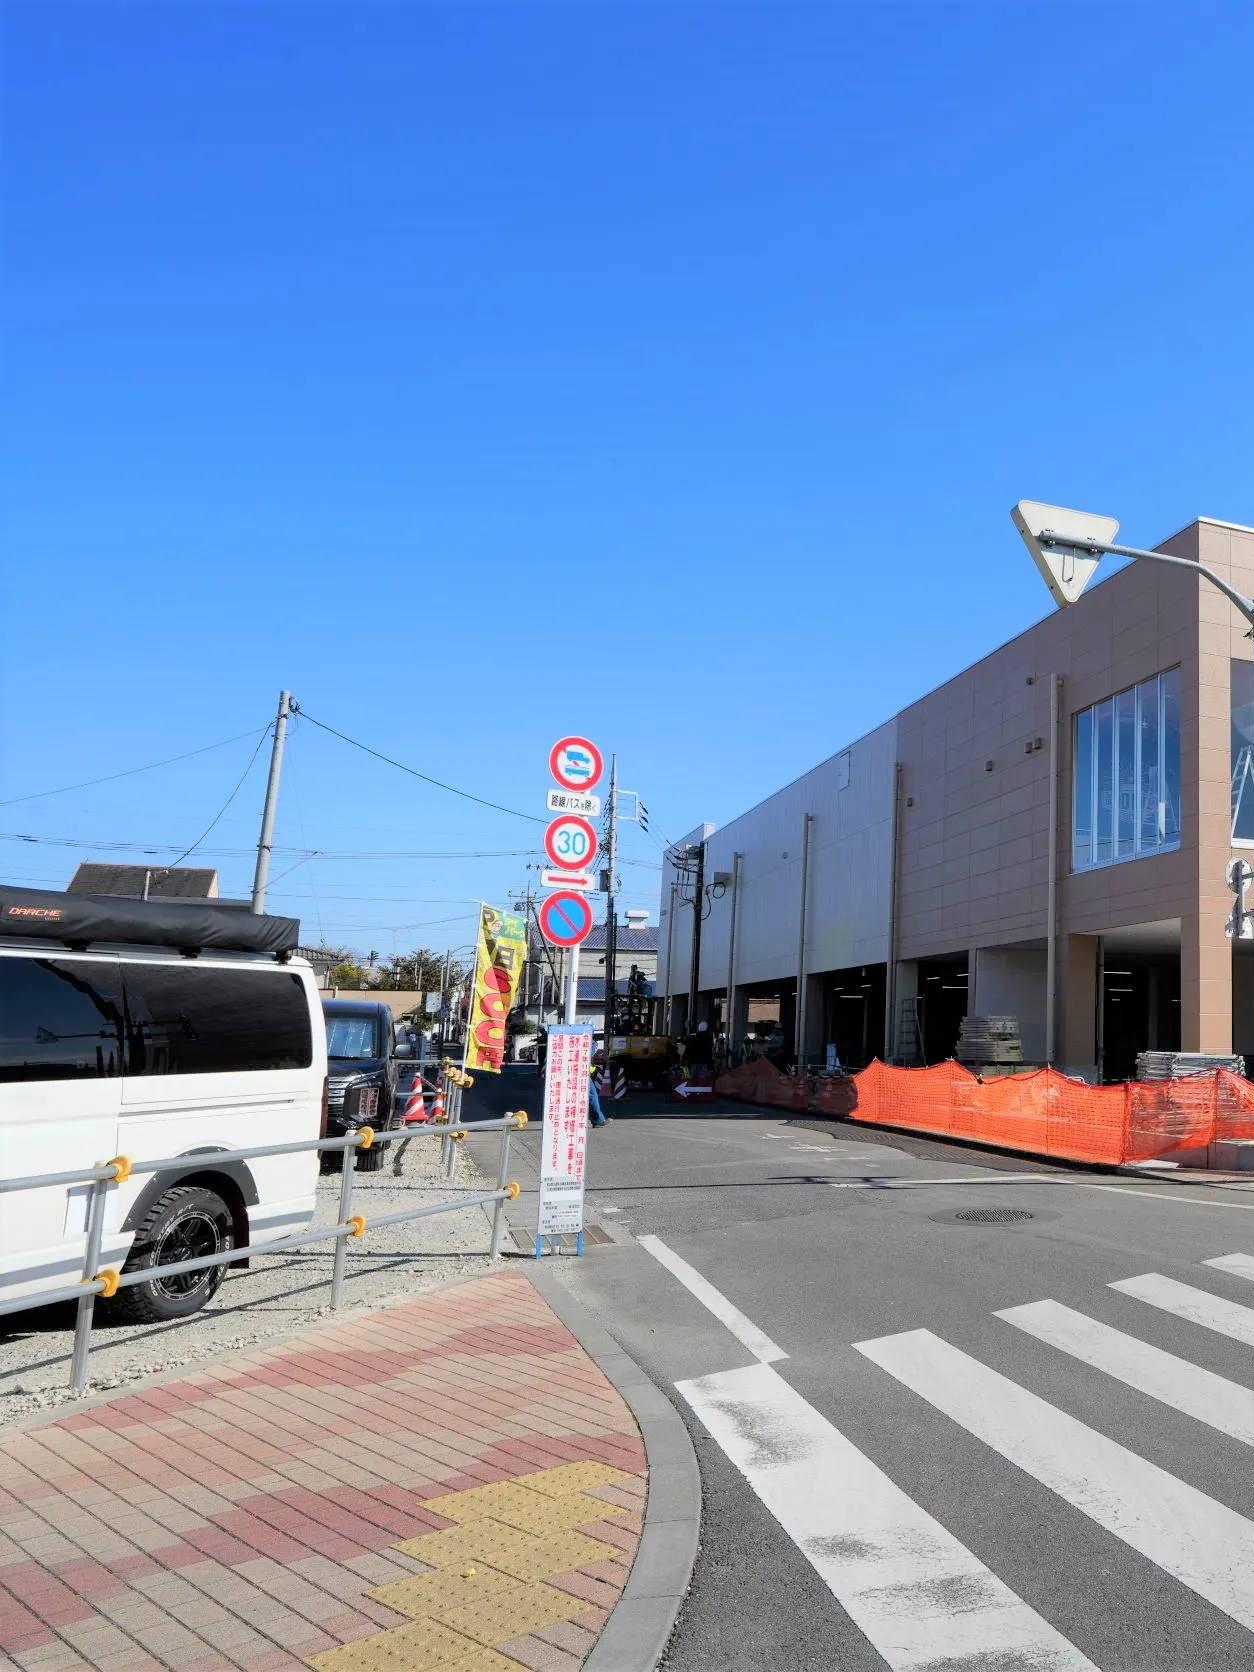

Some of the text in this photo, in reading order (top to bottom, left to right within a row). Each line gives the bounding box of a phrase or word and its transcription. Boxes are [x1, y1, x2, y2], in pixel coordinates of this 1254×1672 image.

[551, 794, 596, 812] 路線バスを除く
[557, 830, 587, 856] 30
[8, 907, 62, 917] DARCHE
